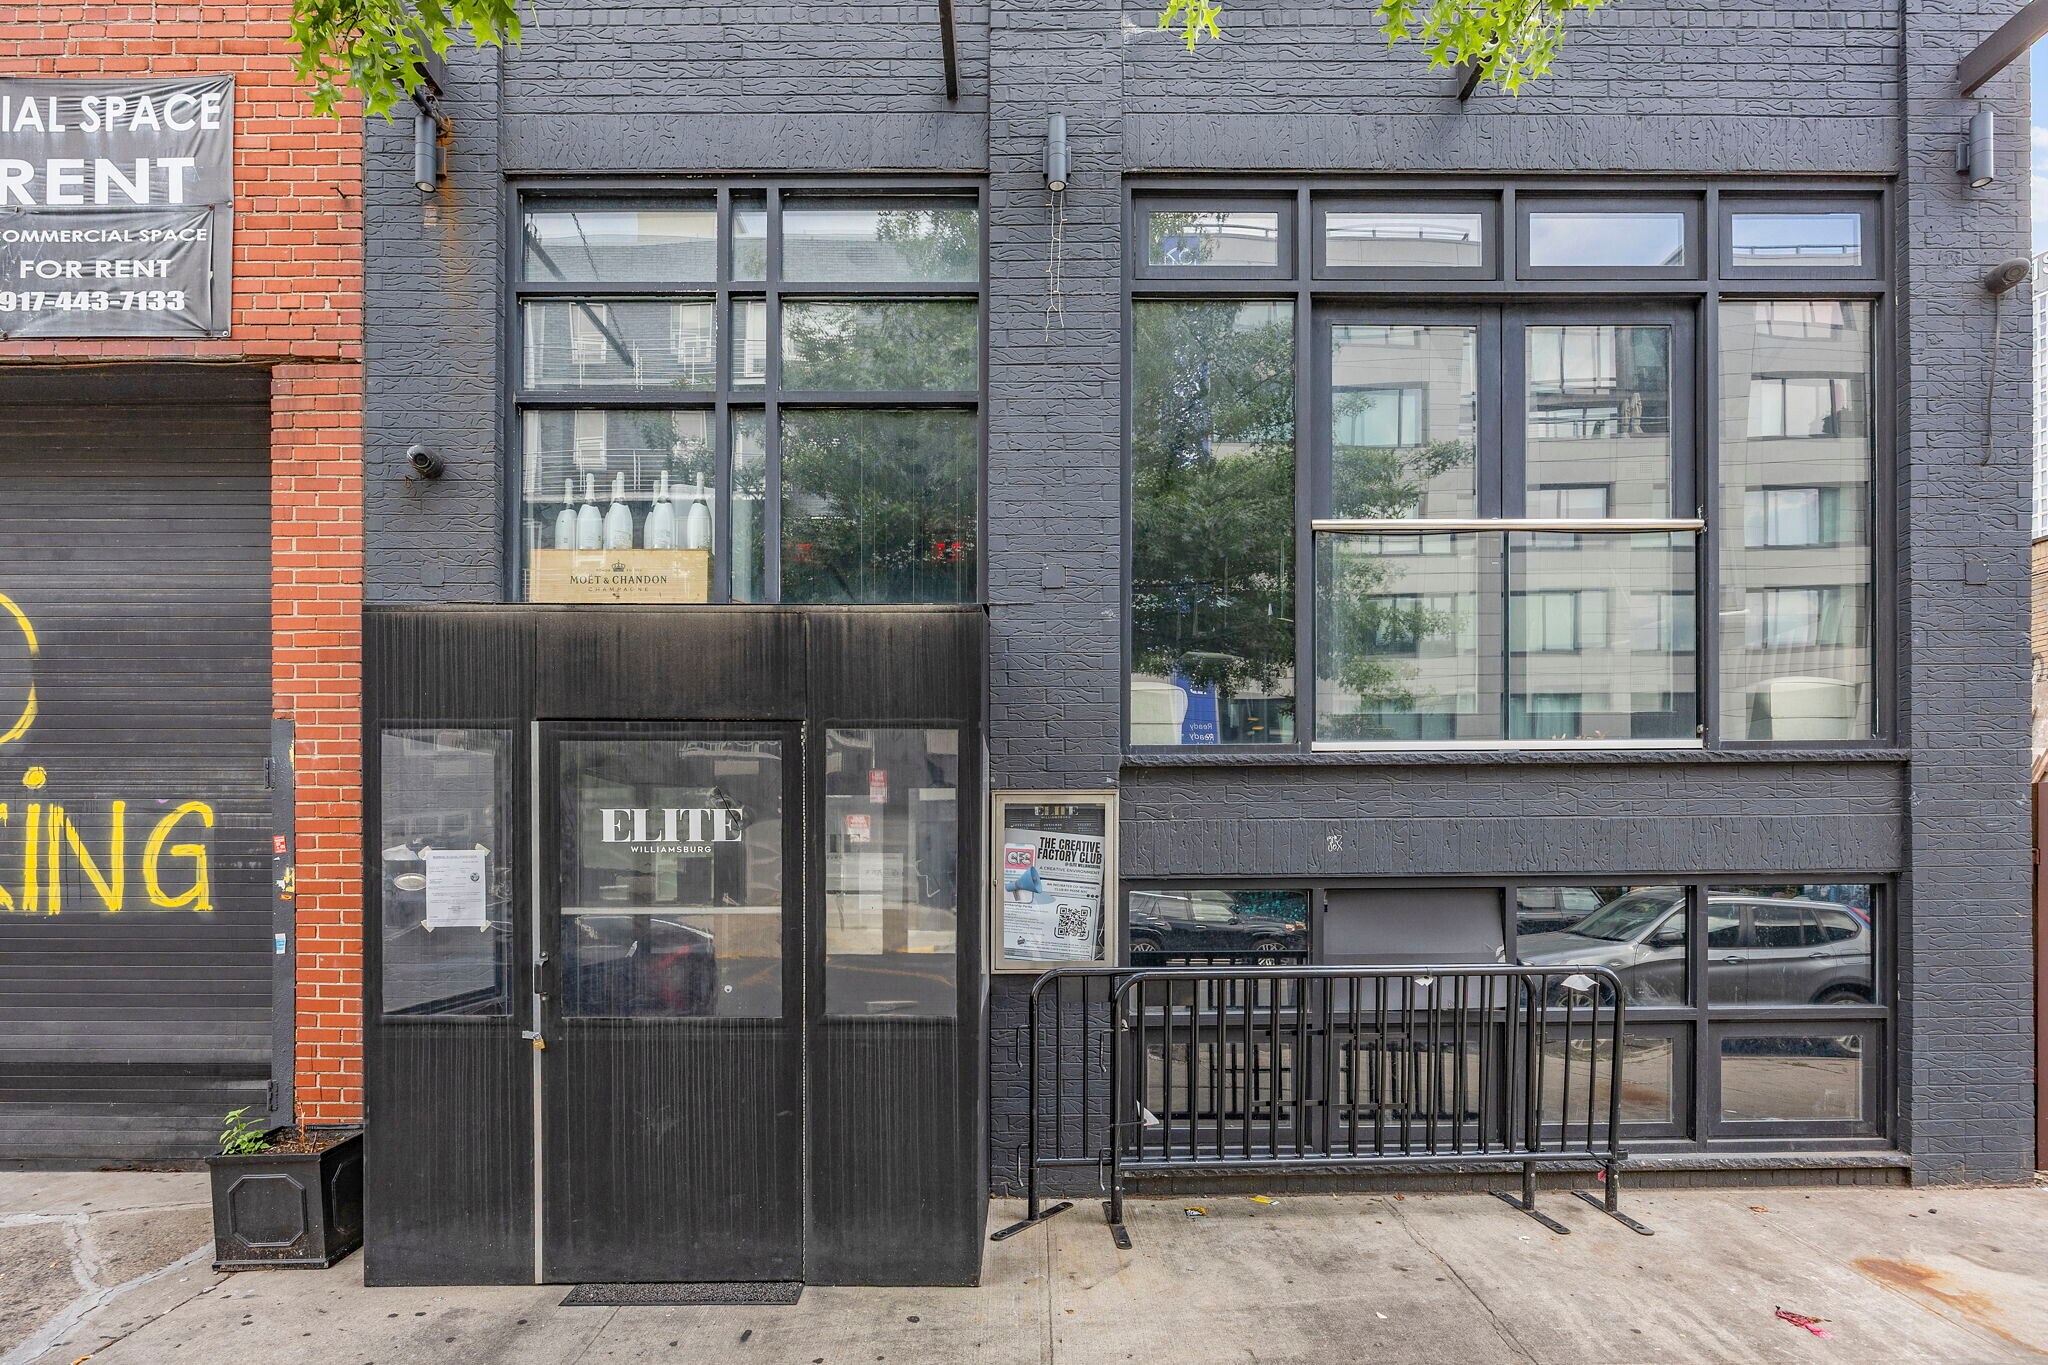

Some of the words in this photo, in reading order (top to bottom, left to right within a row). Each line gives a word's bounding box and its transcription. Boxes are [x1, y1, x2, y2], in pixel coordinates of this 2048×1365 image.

[79, 93, 221, 132] SPACE
[0, 156, 195, 205] RENT
[0, 229, 133, 243] OMMERCIAL
[139, 228, 207, 242] SPACE
[20, 260, 83, 279] FOR
[95, 259, 172, 278] RENT
[0, 291, 185, 312] 917-443-7133
[570, 573, 601, 585] MOËT
[612, 575, 668, 585] CHANDON
[600, 808, 743, 842] ELITE
[630, 845, 712, 853] WILLIAMSBURG
[1040, 836, 1056, 850] THE
[1058, 838, 1101, 853] CREATIVE
[1037, 848, 1077, 862] FACTORY
[1079, 852, 1103, 864] CLUB
